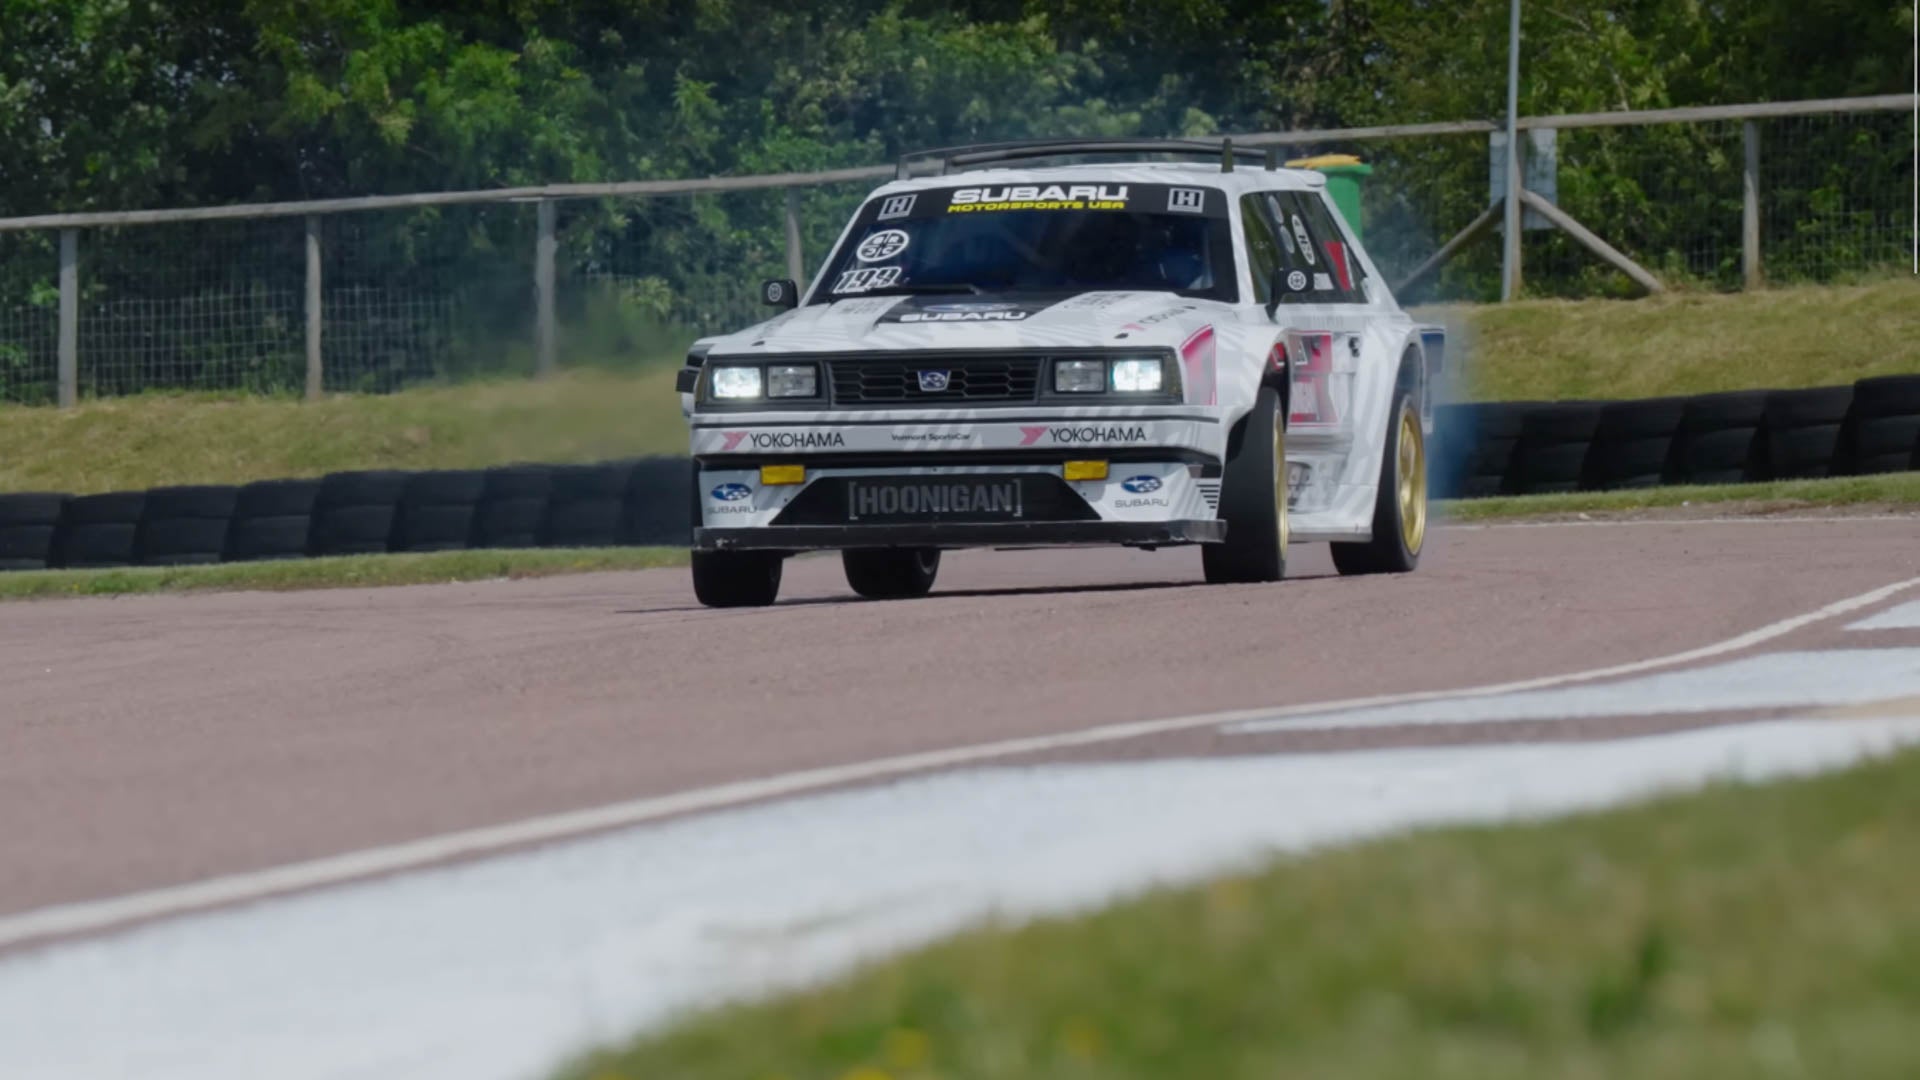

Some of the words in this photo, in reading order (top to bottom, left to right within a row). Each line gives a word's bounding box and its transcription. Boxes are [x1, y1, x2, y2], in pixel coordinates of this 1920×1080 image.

[951, 186, 1127, 204] SUBARU
[947, 201, 1084, 213] MOTORSPORTS
[1088, 200, 1126, 210] USA
[900, 311, 1026, 322] SUBARU
[750, 432, 844, 448] YOKOHAMA
[1049, 427, 1146, 443] YOKOHAMA
[706, 504, 757, 515] SUBARU
[1114, 498, 1170, 509] SUBARU
